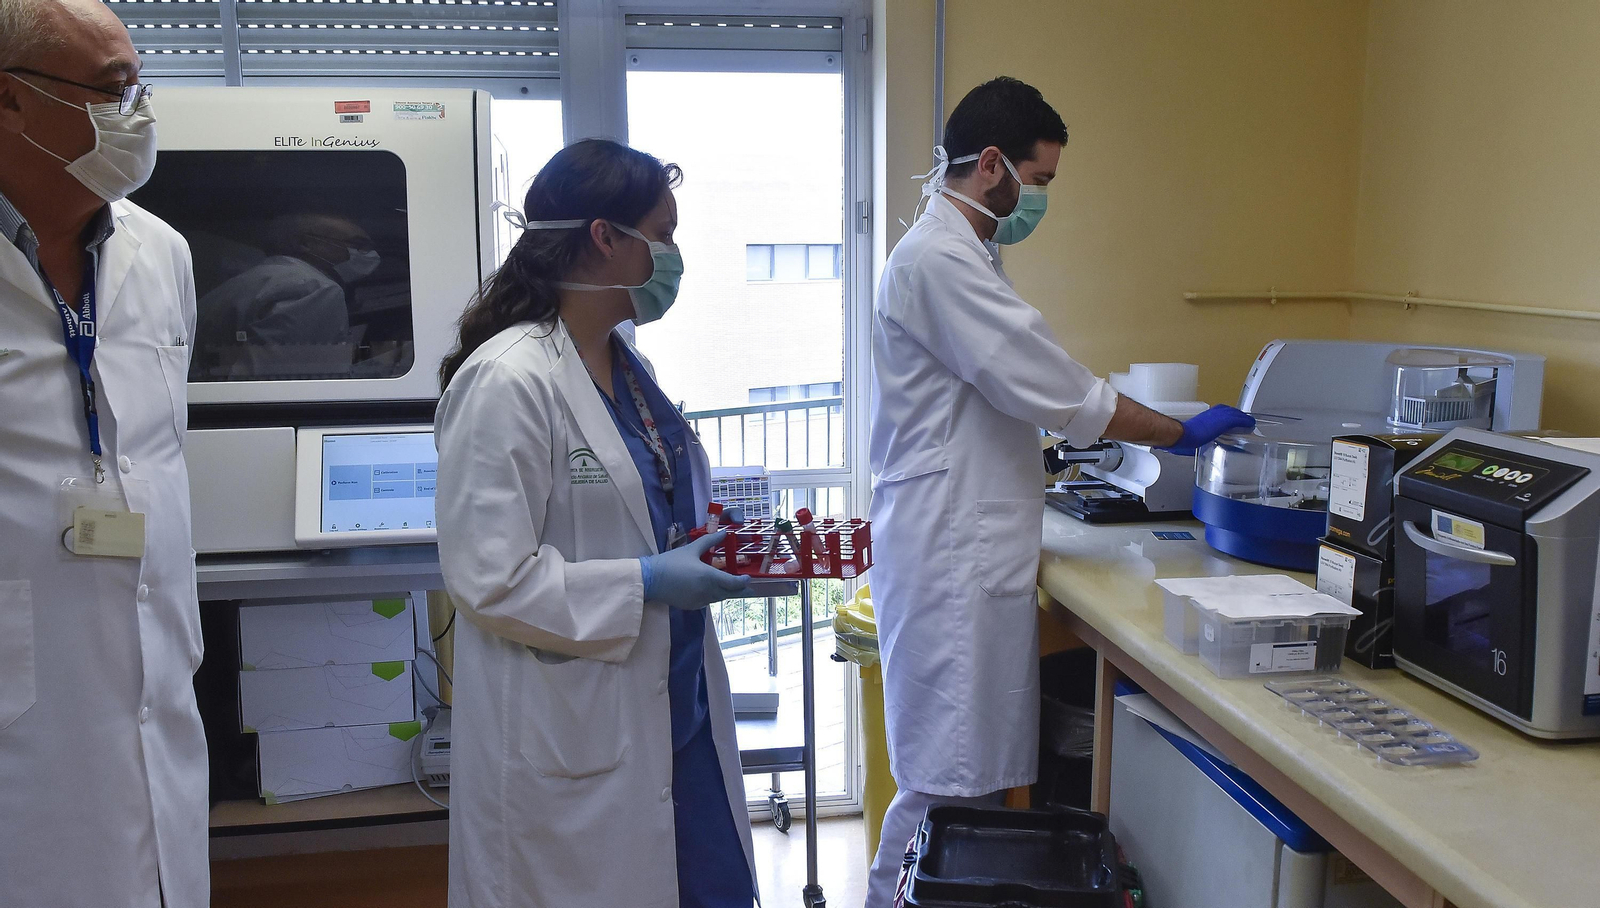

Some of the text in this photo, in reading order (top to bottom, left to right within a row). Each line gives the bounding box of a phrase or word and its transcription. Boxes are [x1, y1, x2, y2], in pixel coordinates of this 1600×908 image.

[274, 136, 380, 148] ELITe InGenius
[82, 292, 91, 320] Abbott
[62, 307, 76, 338] Abbott
[1491, 648, 1507, 676] 16
